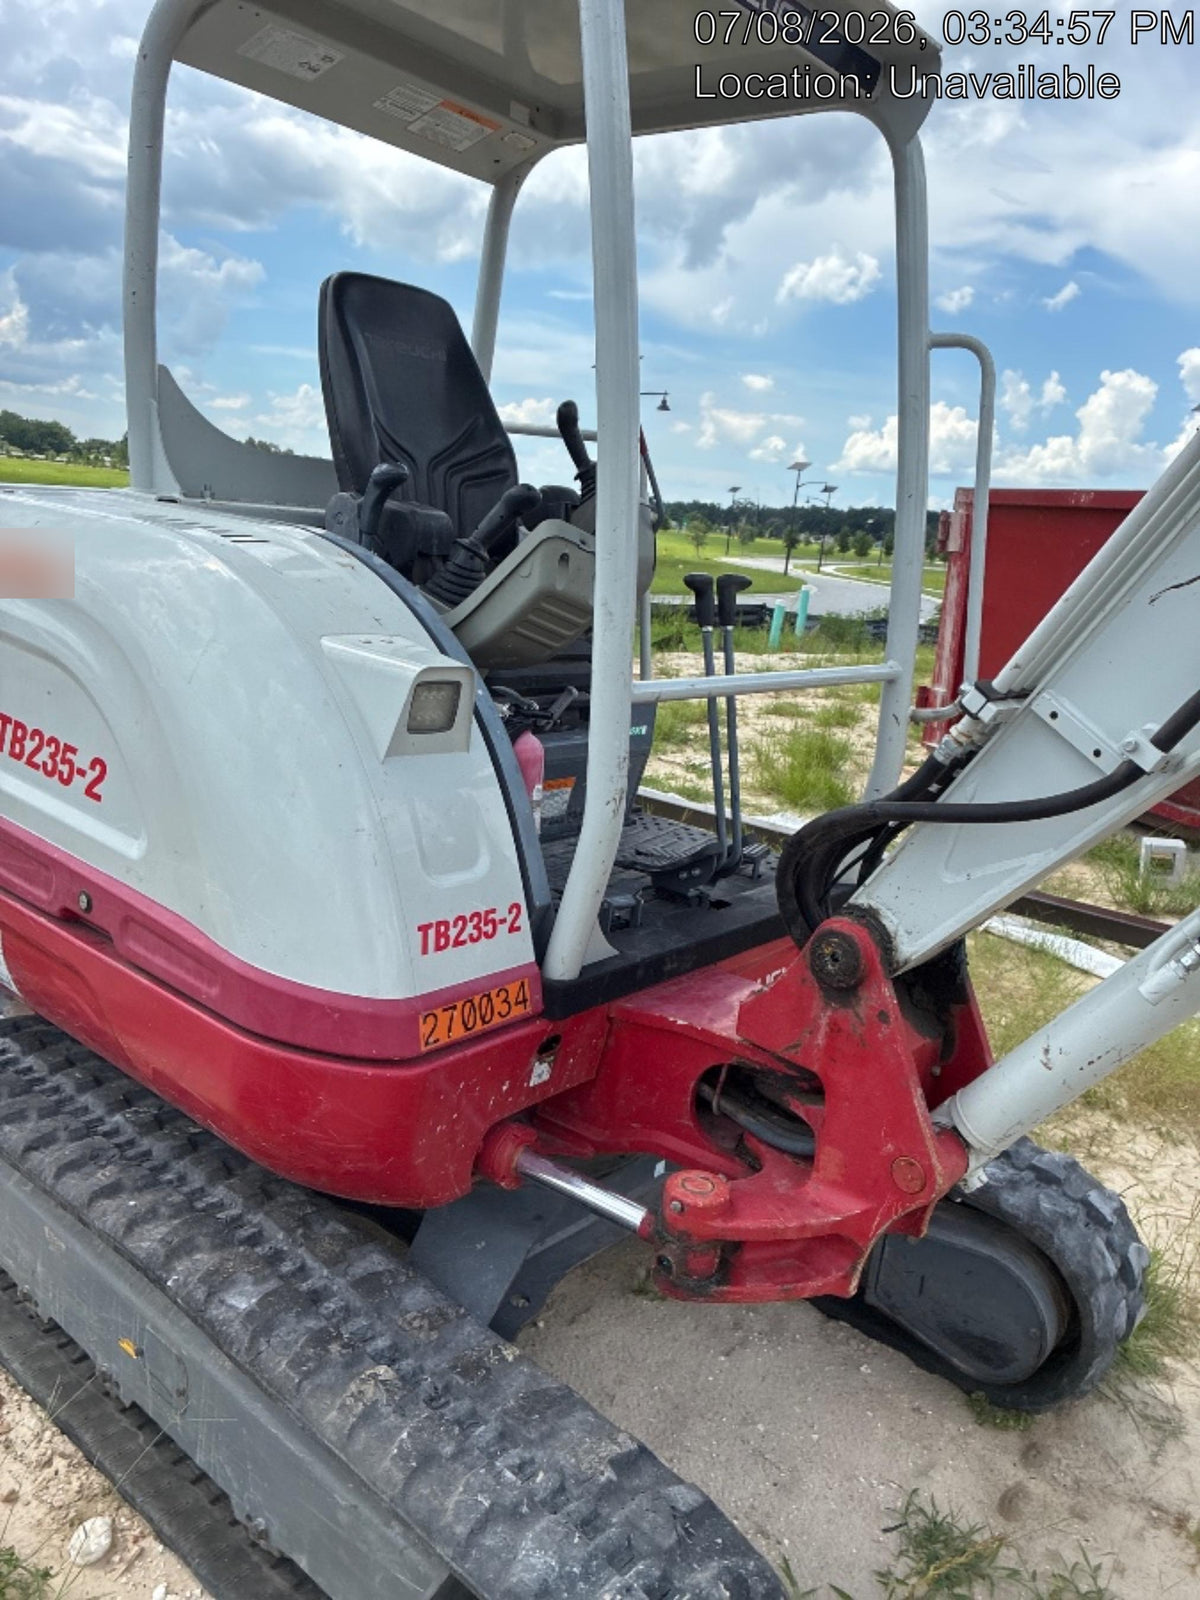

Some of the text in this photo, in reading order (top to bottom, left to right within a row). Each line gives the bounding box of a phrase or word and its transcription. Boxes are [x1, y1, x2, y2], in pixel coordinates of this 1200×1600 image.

[0, 712, 107, 802] TB235-2
[417, 902, 522, 956] TB235-2
[422, 980, 529, 1047] 270034
